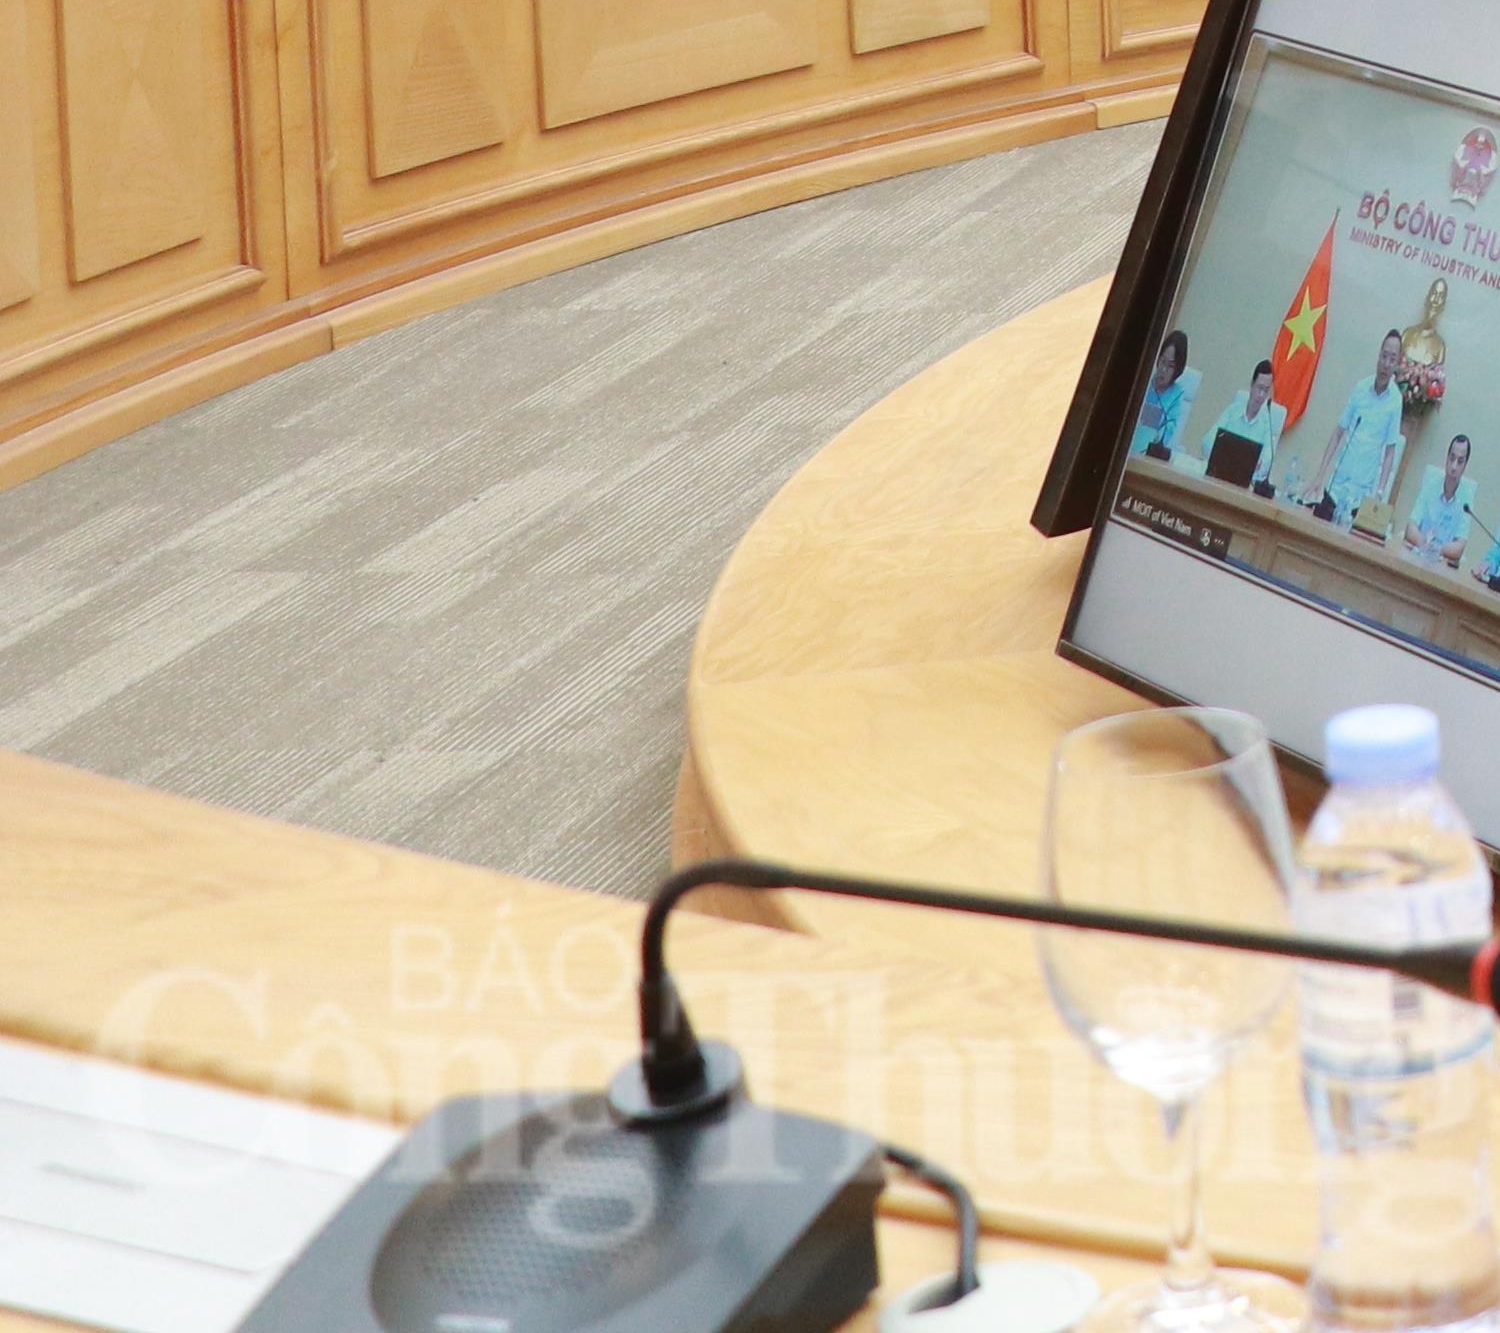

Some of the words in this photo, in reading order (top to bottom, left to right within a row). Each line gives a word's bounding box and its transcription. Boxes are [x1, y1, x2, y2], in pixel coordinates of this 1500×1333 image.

[1356, 183, 1391, 230] BỘ
[1391, 194, 1459, 249] CÔNG
[1350, 225, 1398, 255] MINISTRY
[1402, 243, 1417, 261] OF
[1420, 248, 1476, 282] INDUSTRY
